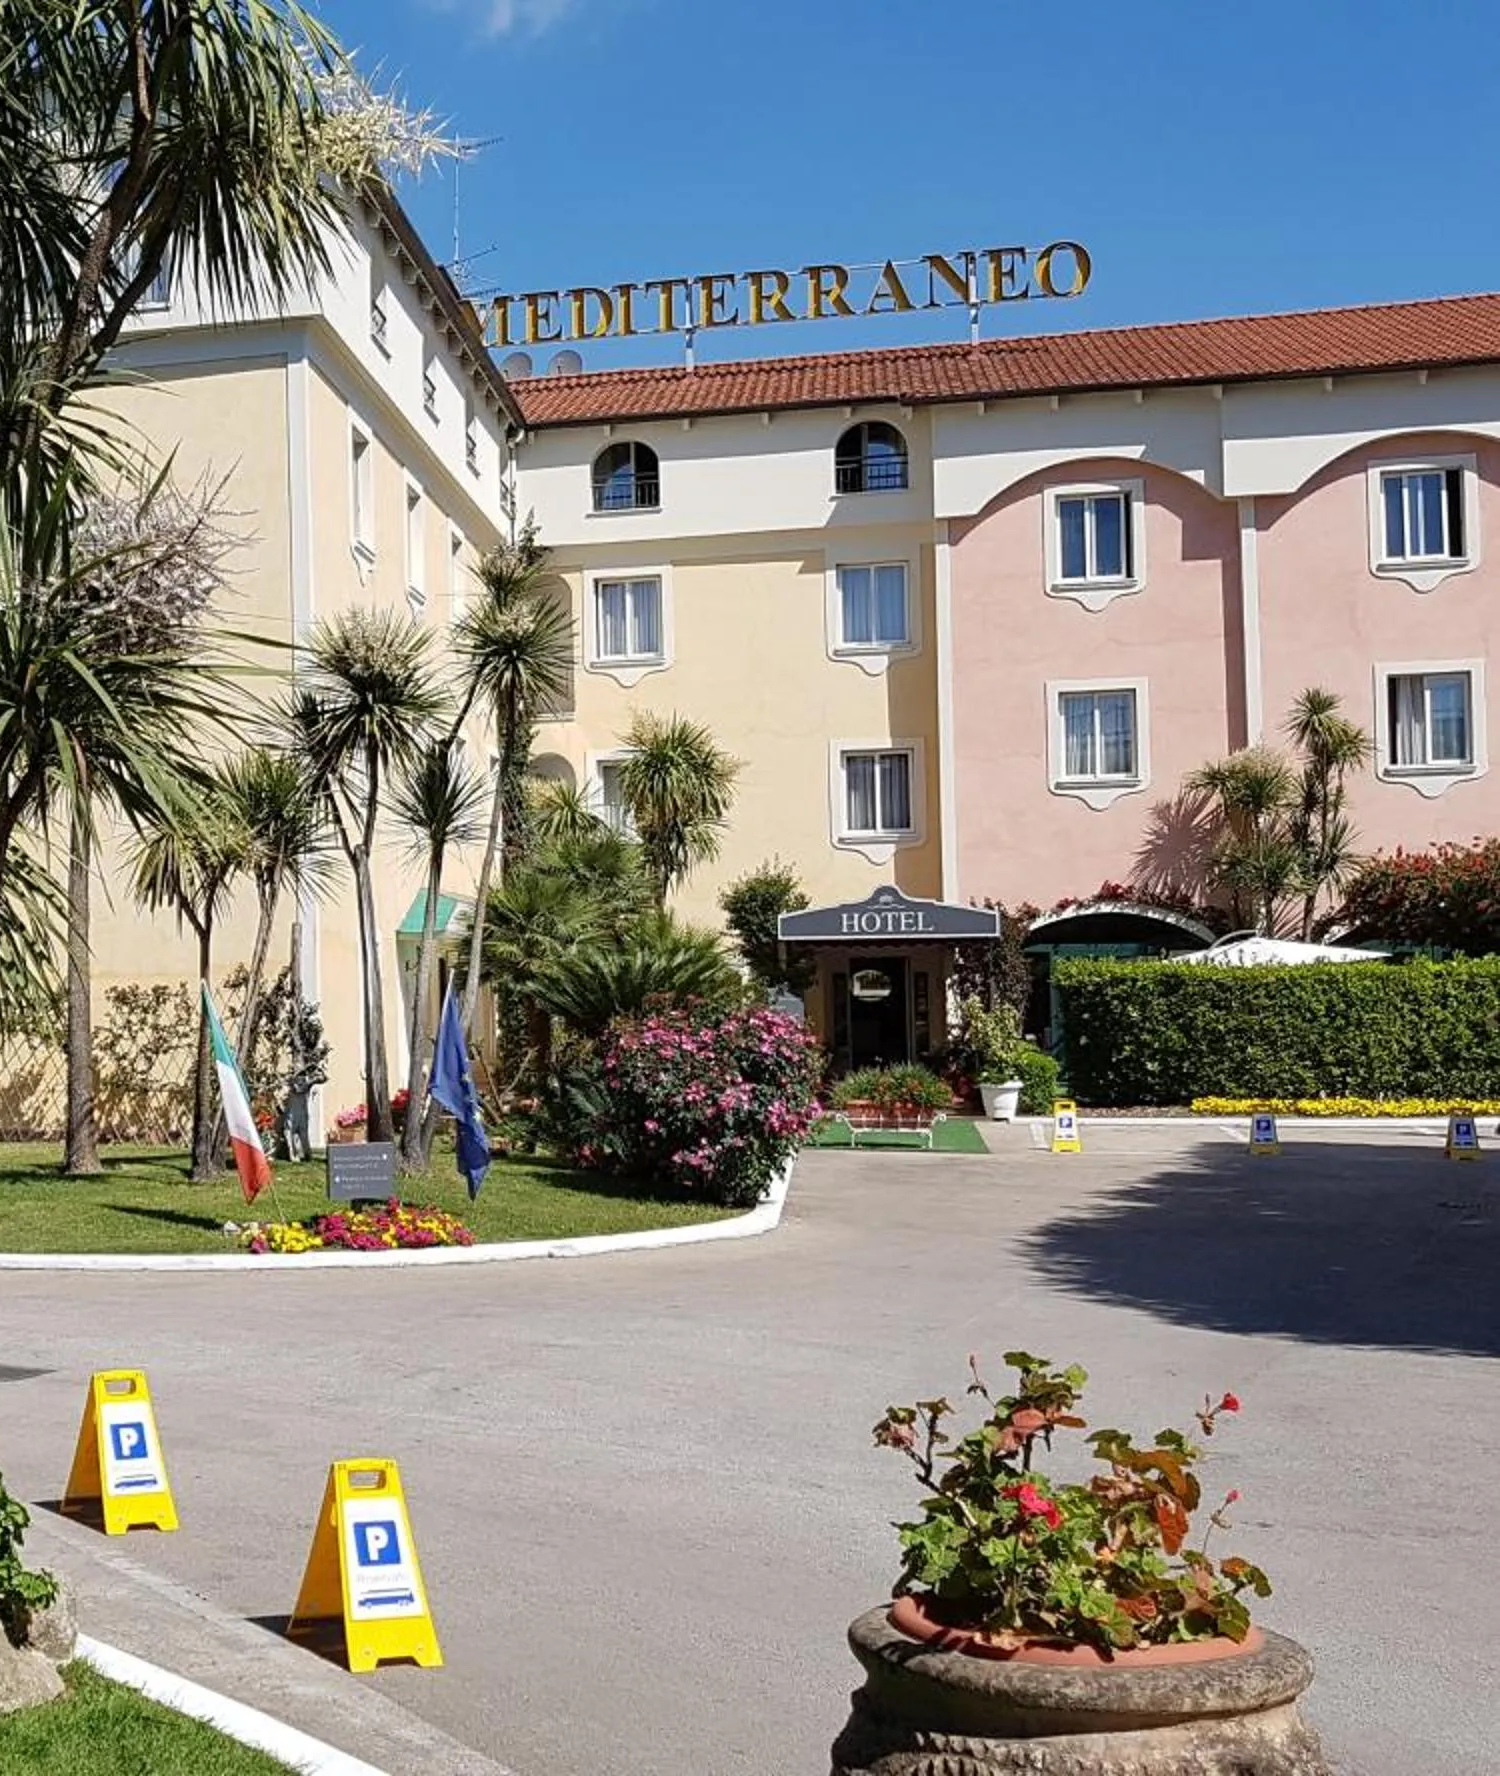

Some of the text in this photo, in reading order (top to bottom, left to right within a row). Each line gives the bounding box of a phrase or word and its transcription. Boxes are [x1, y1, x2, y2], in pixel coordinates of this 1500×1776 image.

[841, 911, 934, 933] HOTEL
[118, 1427, 138, 1457] P
[364, 1526, 389, 1561] P
